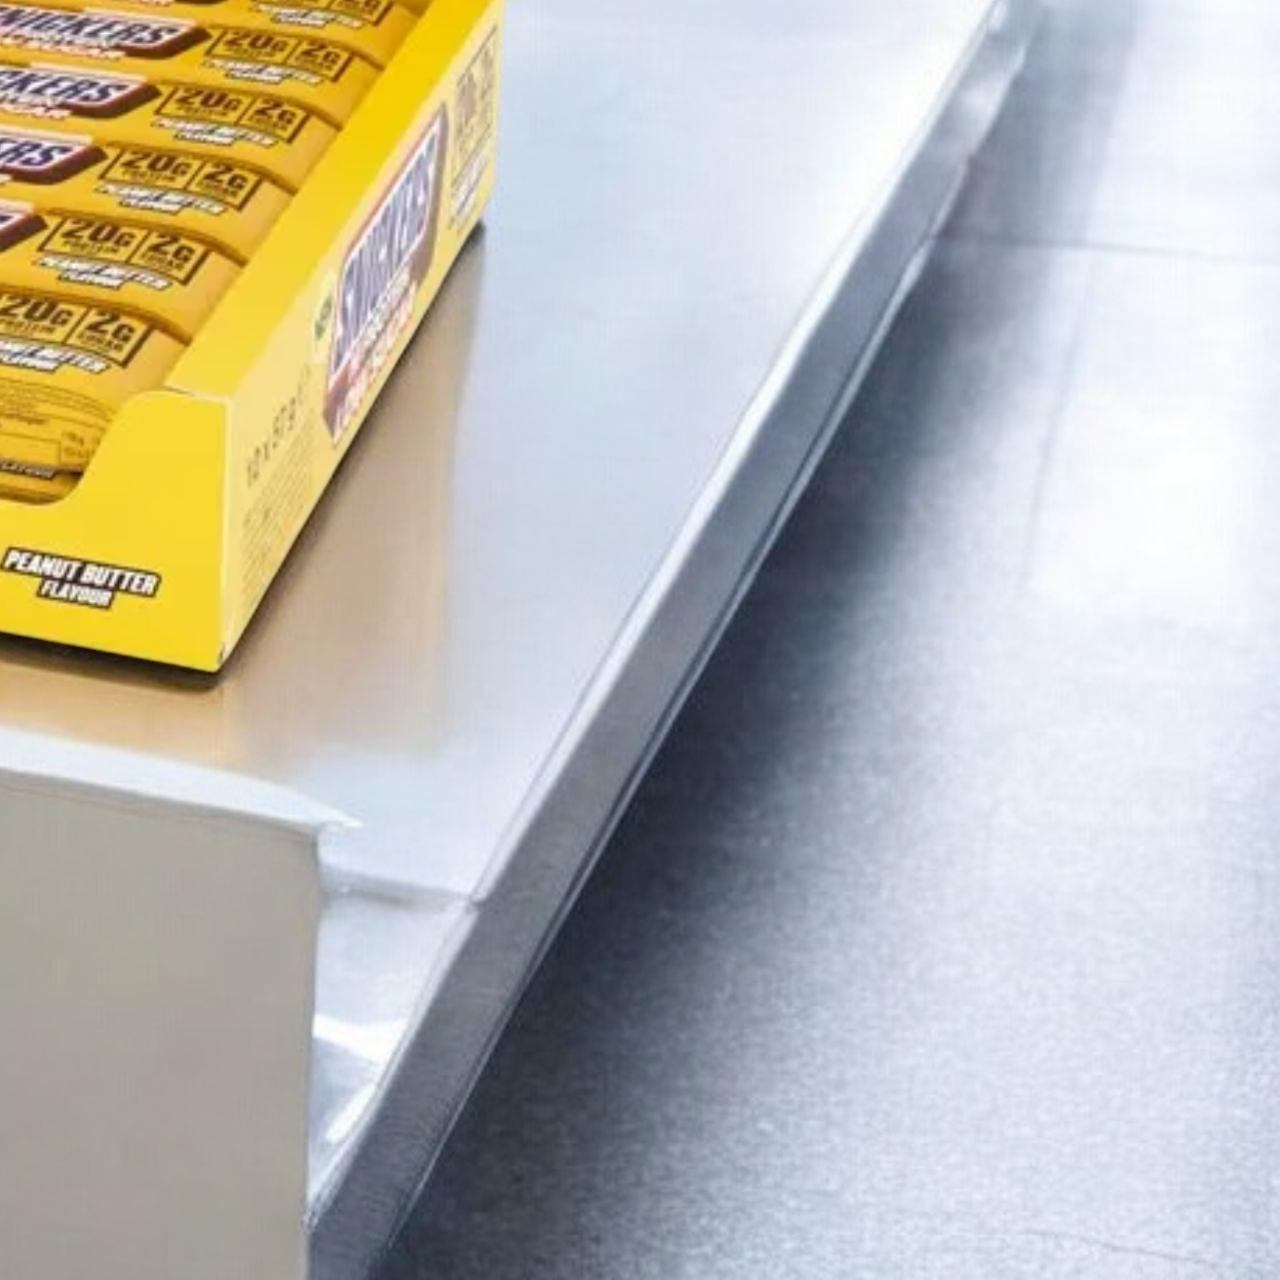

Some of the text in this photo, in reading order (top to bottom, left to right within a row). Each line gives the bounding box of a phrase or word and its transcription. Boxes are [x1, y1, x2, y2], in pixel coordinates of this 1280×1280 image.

[4, 550, 158, 595] PEANUT BUTTER
[41, 580, 113, 607] FLAVOUR
